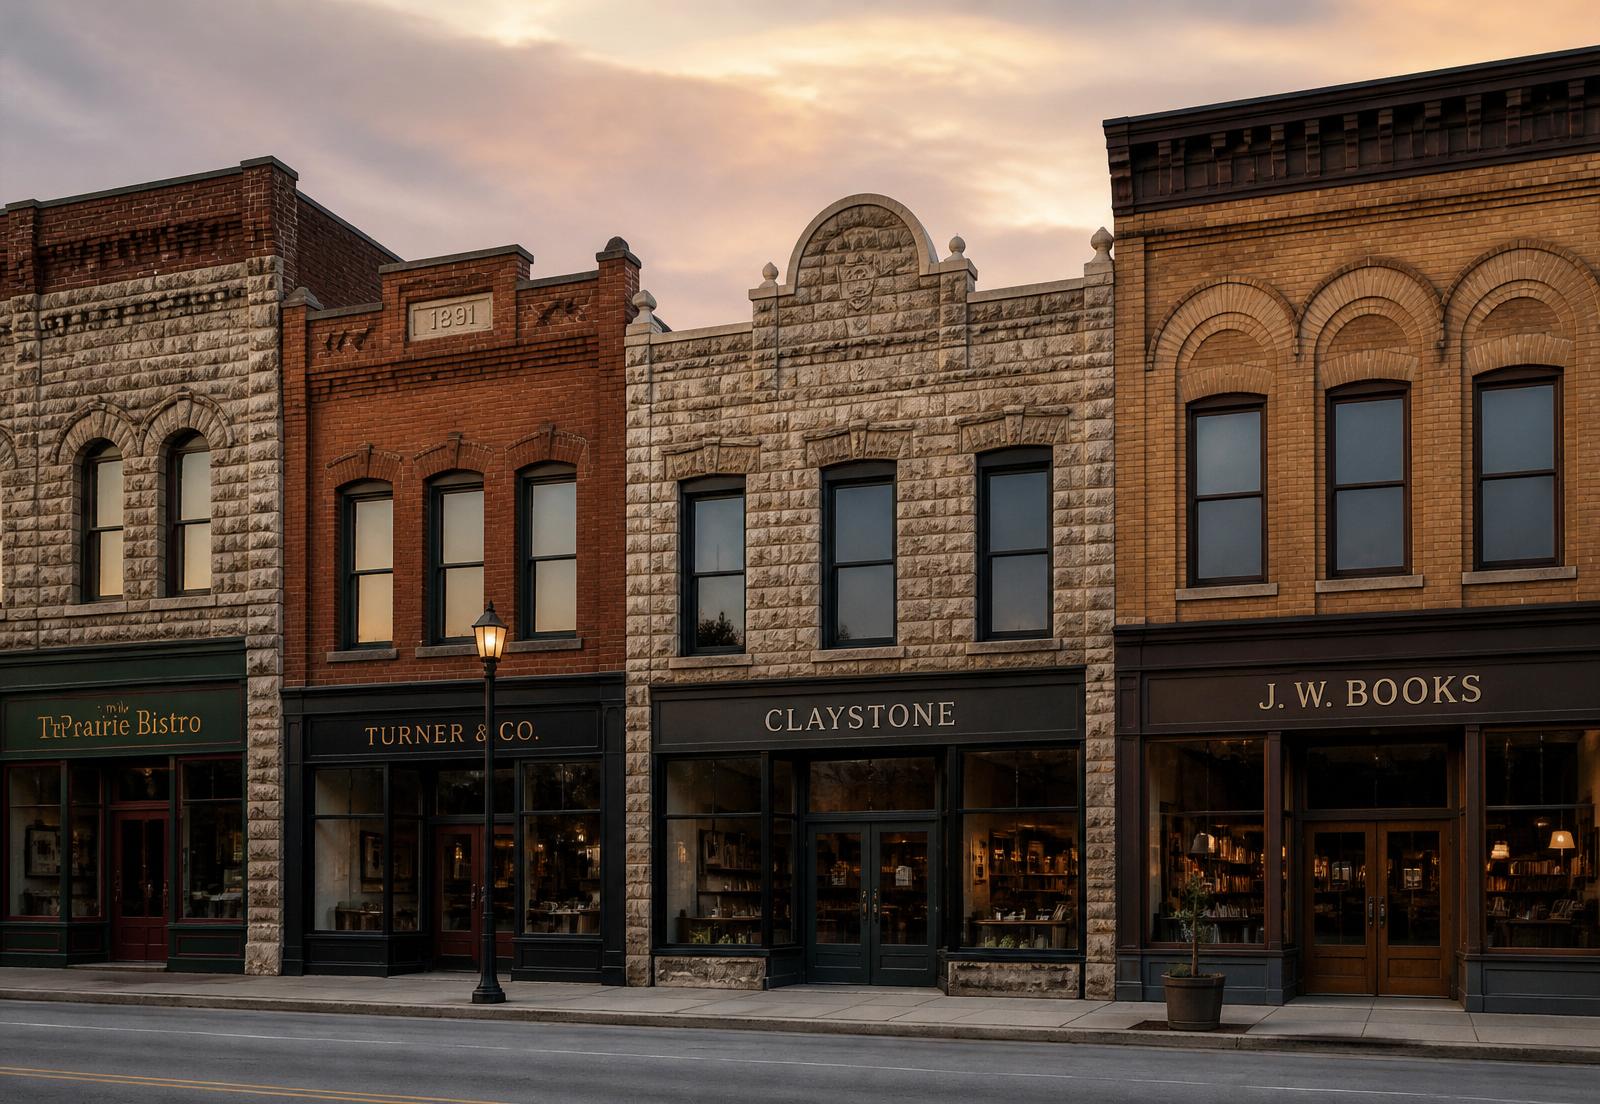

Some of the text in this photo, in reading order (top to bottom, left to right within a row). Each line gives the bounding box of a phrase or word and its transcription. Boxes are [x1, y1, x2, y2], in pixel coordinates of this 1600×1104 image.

[431, 304, 475, 330] 1891
[1258, 674, 1482, 710] J. W. BOOKS
[136, 709, 202, 736] Bistro
[764, 701, 956, 732] CLAYSTONE
[364, 720, 540, 746] TURNER & CO.
